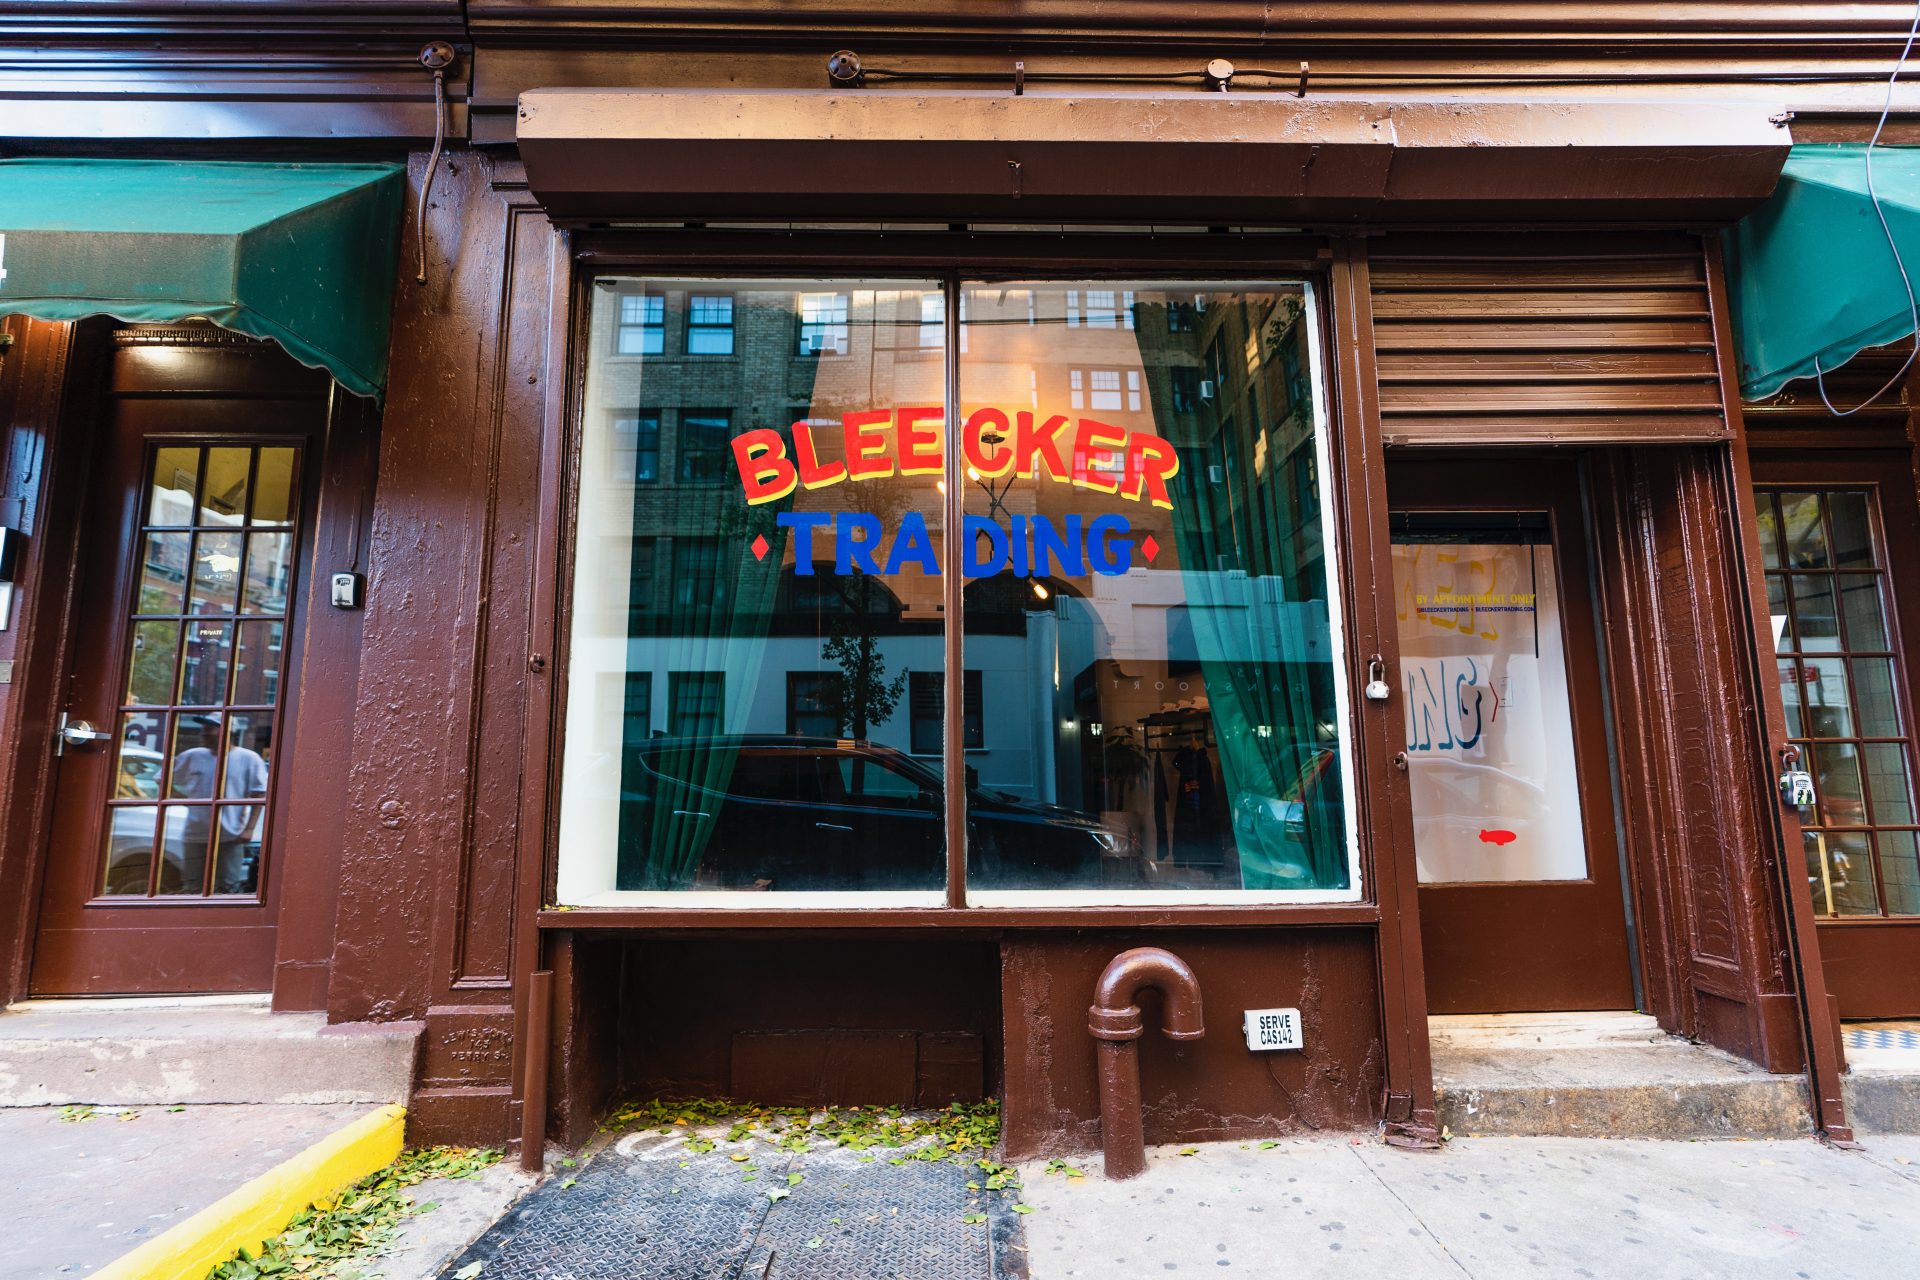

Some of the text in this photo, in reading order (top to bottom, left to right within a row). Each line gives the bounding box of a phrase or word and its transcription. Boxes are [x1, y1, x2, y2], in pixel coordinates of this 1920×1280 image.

[731, 407, 1180, 510] BLEECKER
[776, 511, 1134, 579] TRADING
[1416, 593, 1536, 605] BY APPOINTMENT ONLY
[1259, 1014, 1291, 1030] SERVE
